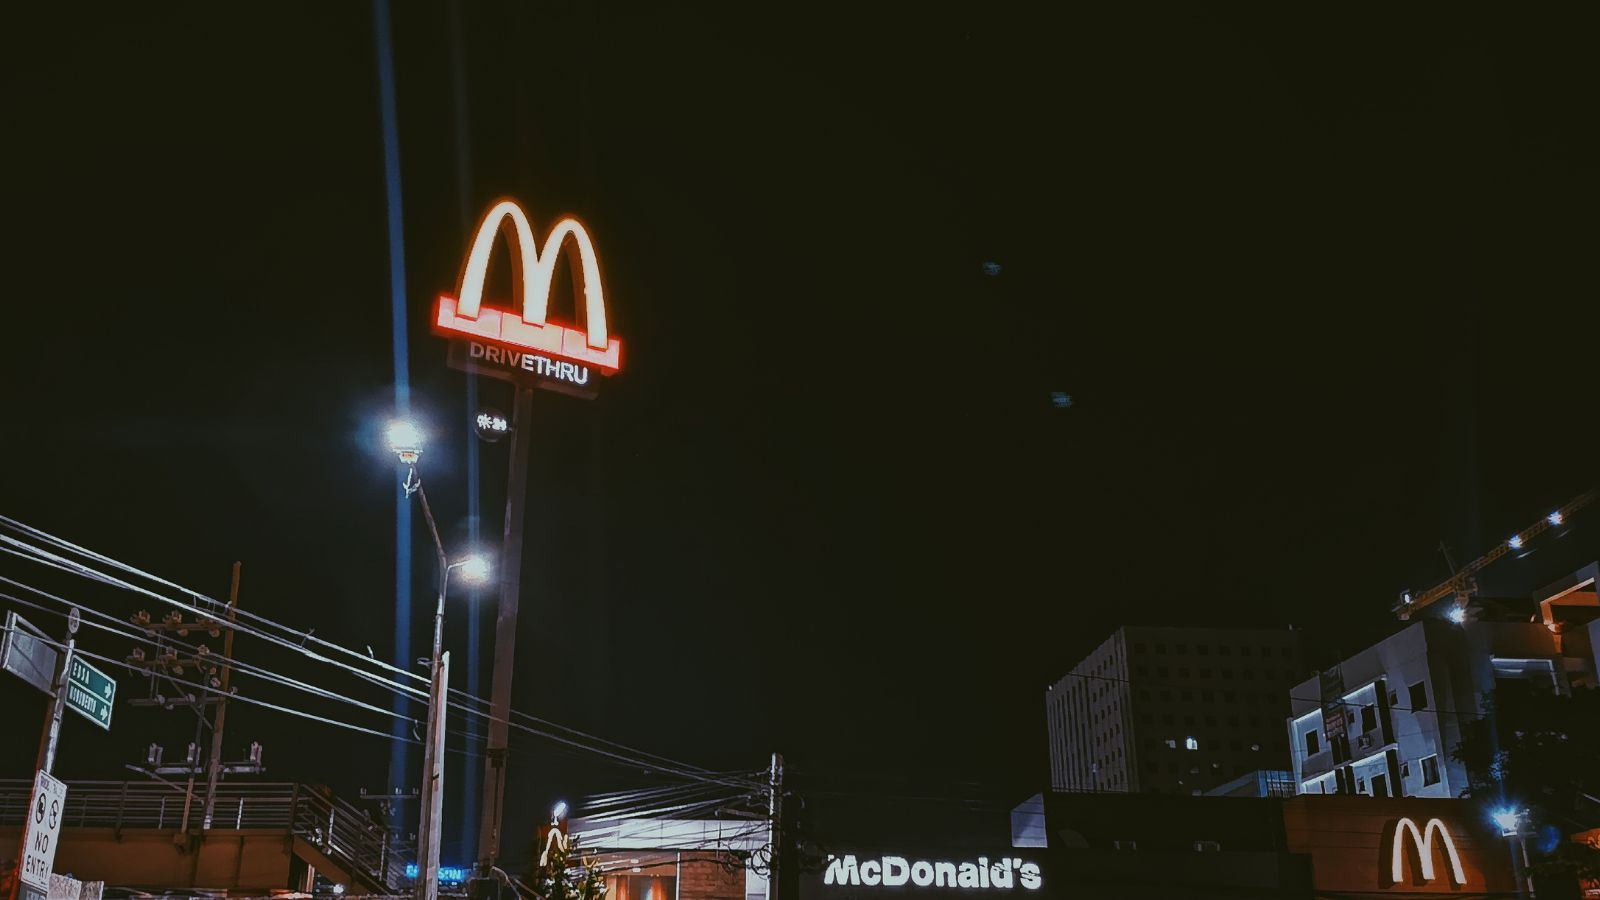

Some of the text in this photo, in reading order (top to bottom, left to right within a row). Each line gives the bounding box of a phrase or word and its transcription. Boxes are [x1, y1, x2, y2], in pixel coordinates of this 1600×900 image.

[35, 831, 49, 854] NO
[25, 854, 49, 879] ENTRY
[823, 854, 1043, 890] McDonald's
